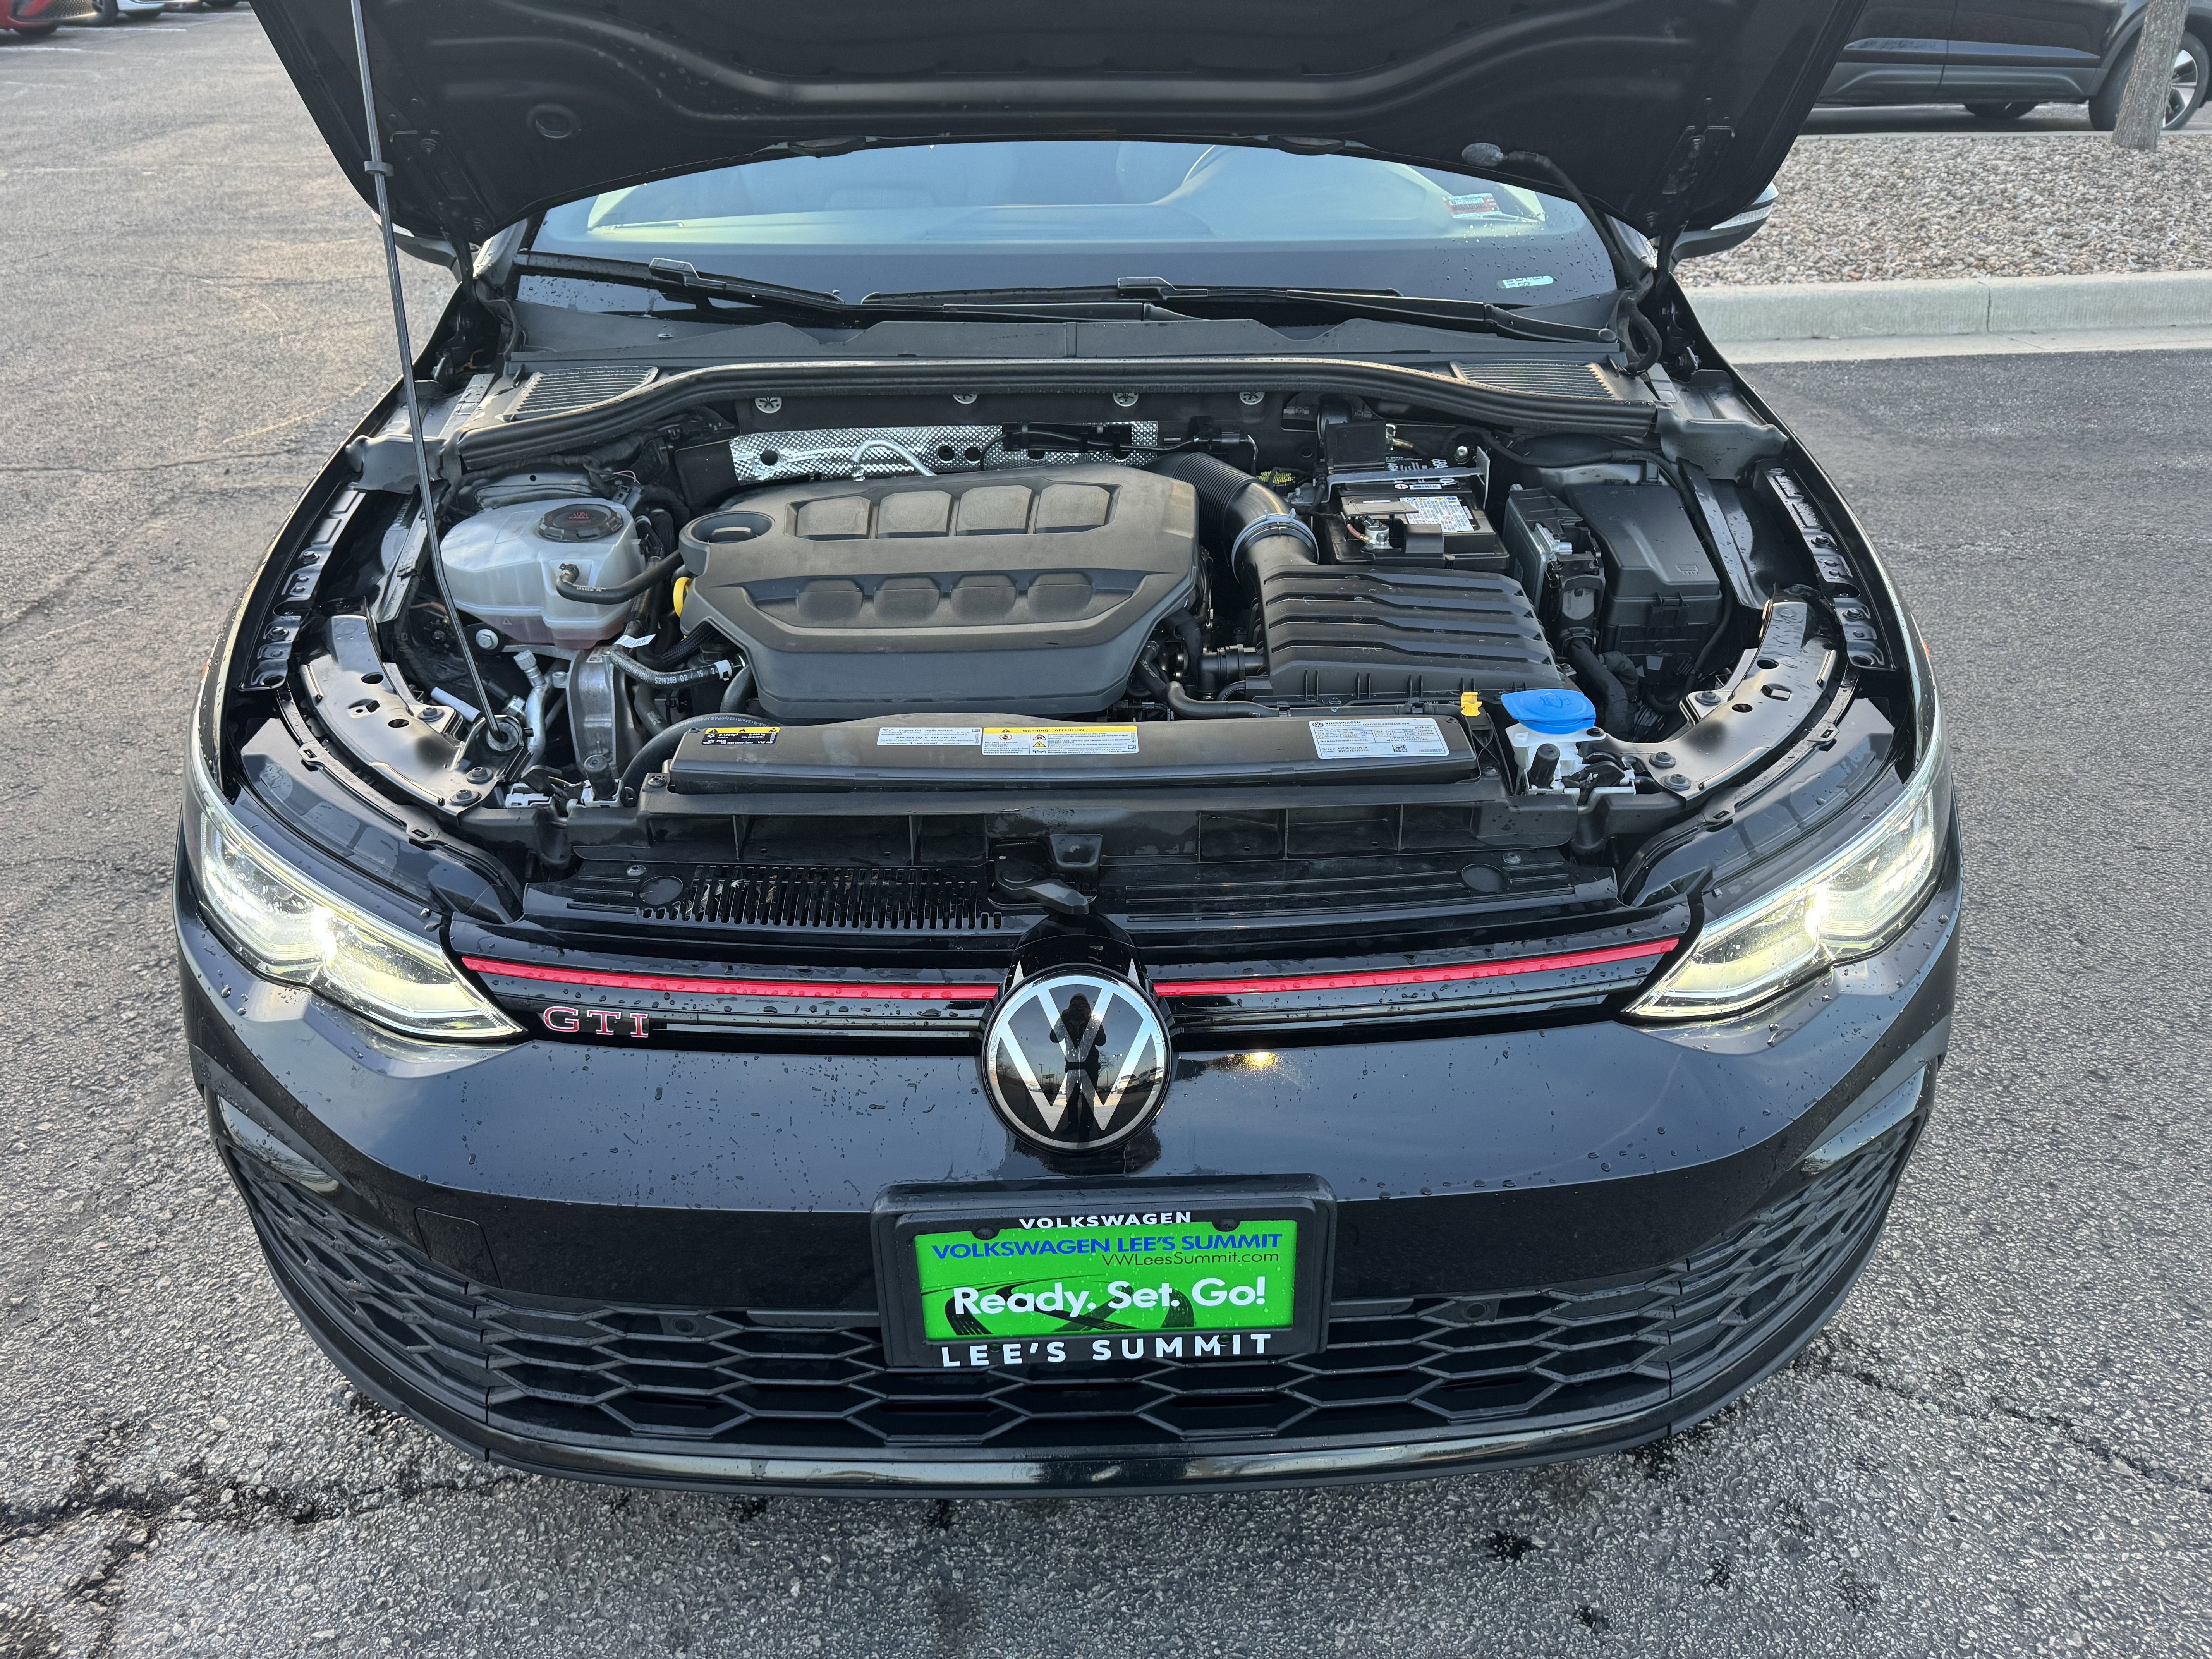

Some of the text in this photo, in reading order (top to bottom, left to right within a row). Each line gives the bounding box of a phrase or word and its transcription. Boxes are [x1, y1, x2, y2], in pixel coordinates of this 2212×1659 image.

[680, 674, 689, 682] 02
[543, 1006, 649, 1038] GTI
[1019, 1211, 1192, 1230] VOLKSWAGEN
[931, 1233, 1283, 1260] VOLKSWAGEN LEE'S SUMMIT
[1101, 1250, 1279, 1267] VWLeesSummit.com
[953, 1276, 1266, 1319] Ready. Set. Go!
[941, 1333, 1272, 1368] LEE'S SUMMIT
